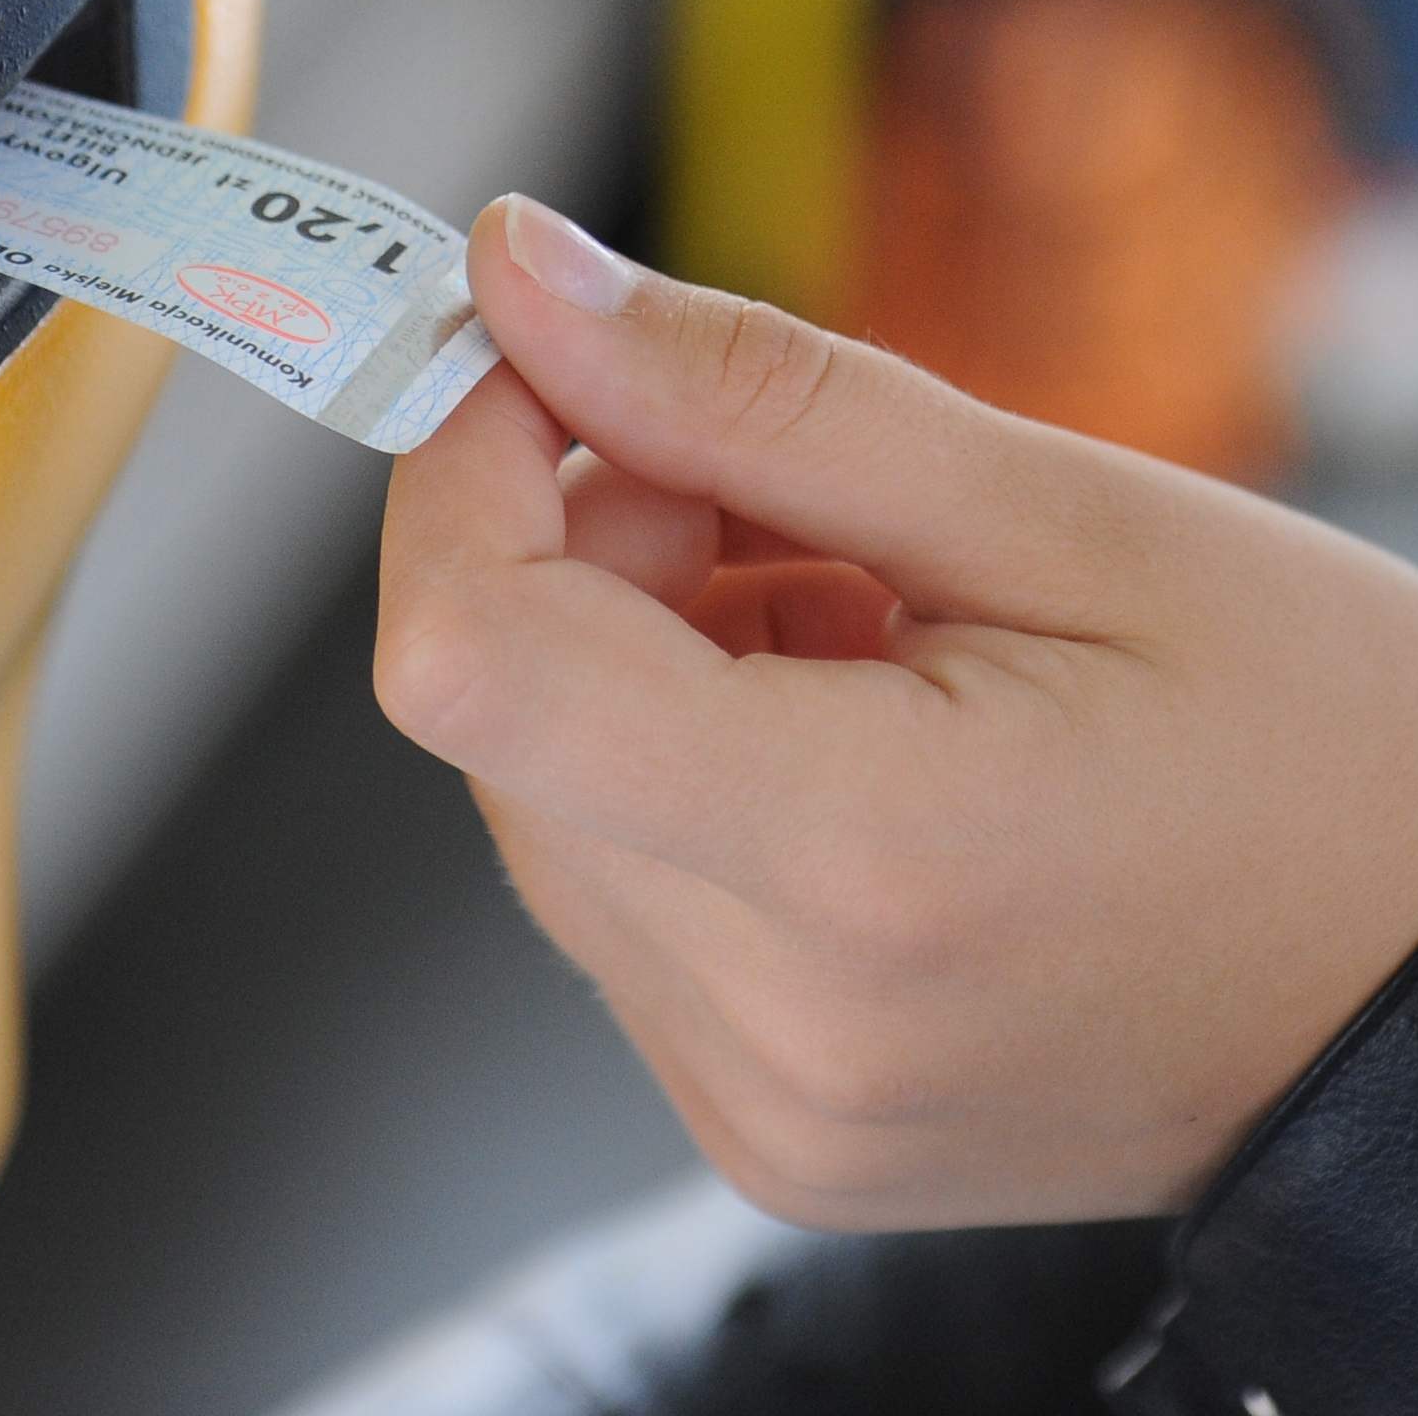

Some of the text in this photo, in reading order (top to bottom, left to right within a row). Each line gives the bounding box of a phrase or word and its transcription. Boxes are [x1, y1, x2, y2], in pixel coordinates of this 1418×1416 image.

[38, 127, 118, 158] BILET
[215, 174, 408, 275] 1,20 zł
[42, 264, 144, 304] Miejska
[207, 284, 293, 327] MPK
[147, 300, 313, 389] Komunikacja
